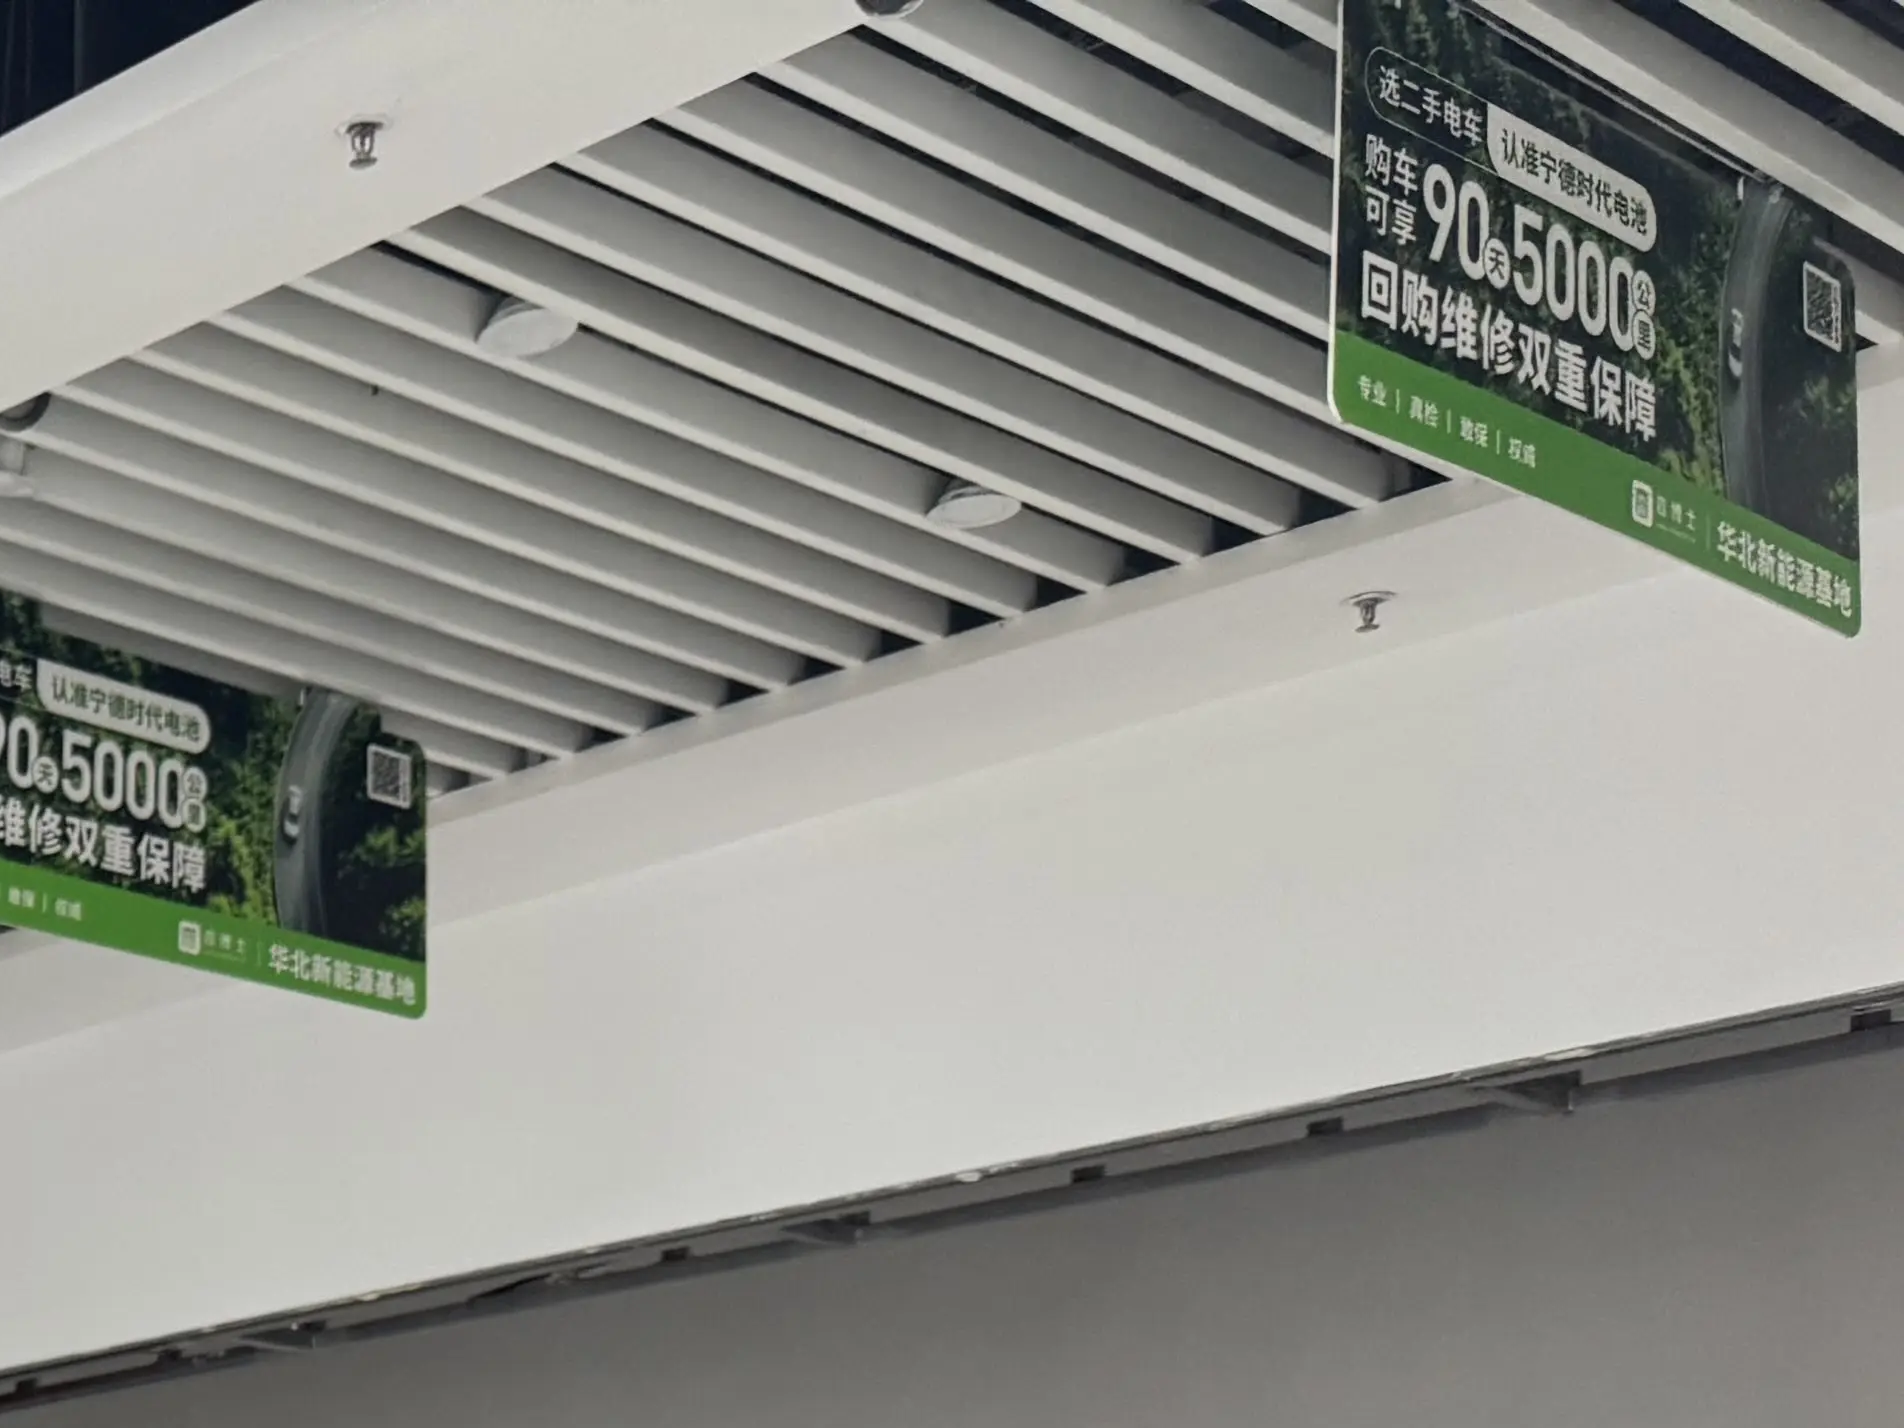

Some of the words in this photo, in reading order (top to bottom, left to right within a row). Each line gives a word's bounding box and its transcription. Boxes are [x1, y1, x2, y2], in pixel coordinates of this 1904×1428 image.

[1366, 134, 1418, 195] 购车
[1379, 65, 1484, 146] 选二手电车
[1501, 128, 1648, 236] 认准宁德时代电池
[1366, 185, 1416, 245] 可享
[1362, 250, 1657, 443] 回购维修双重保障
[1717, 520, 1852, 618] 华北新能源基地
